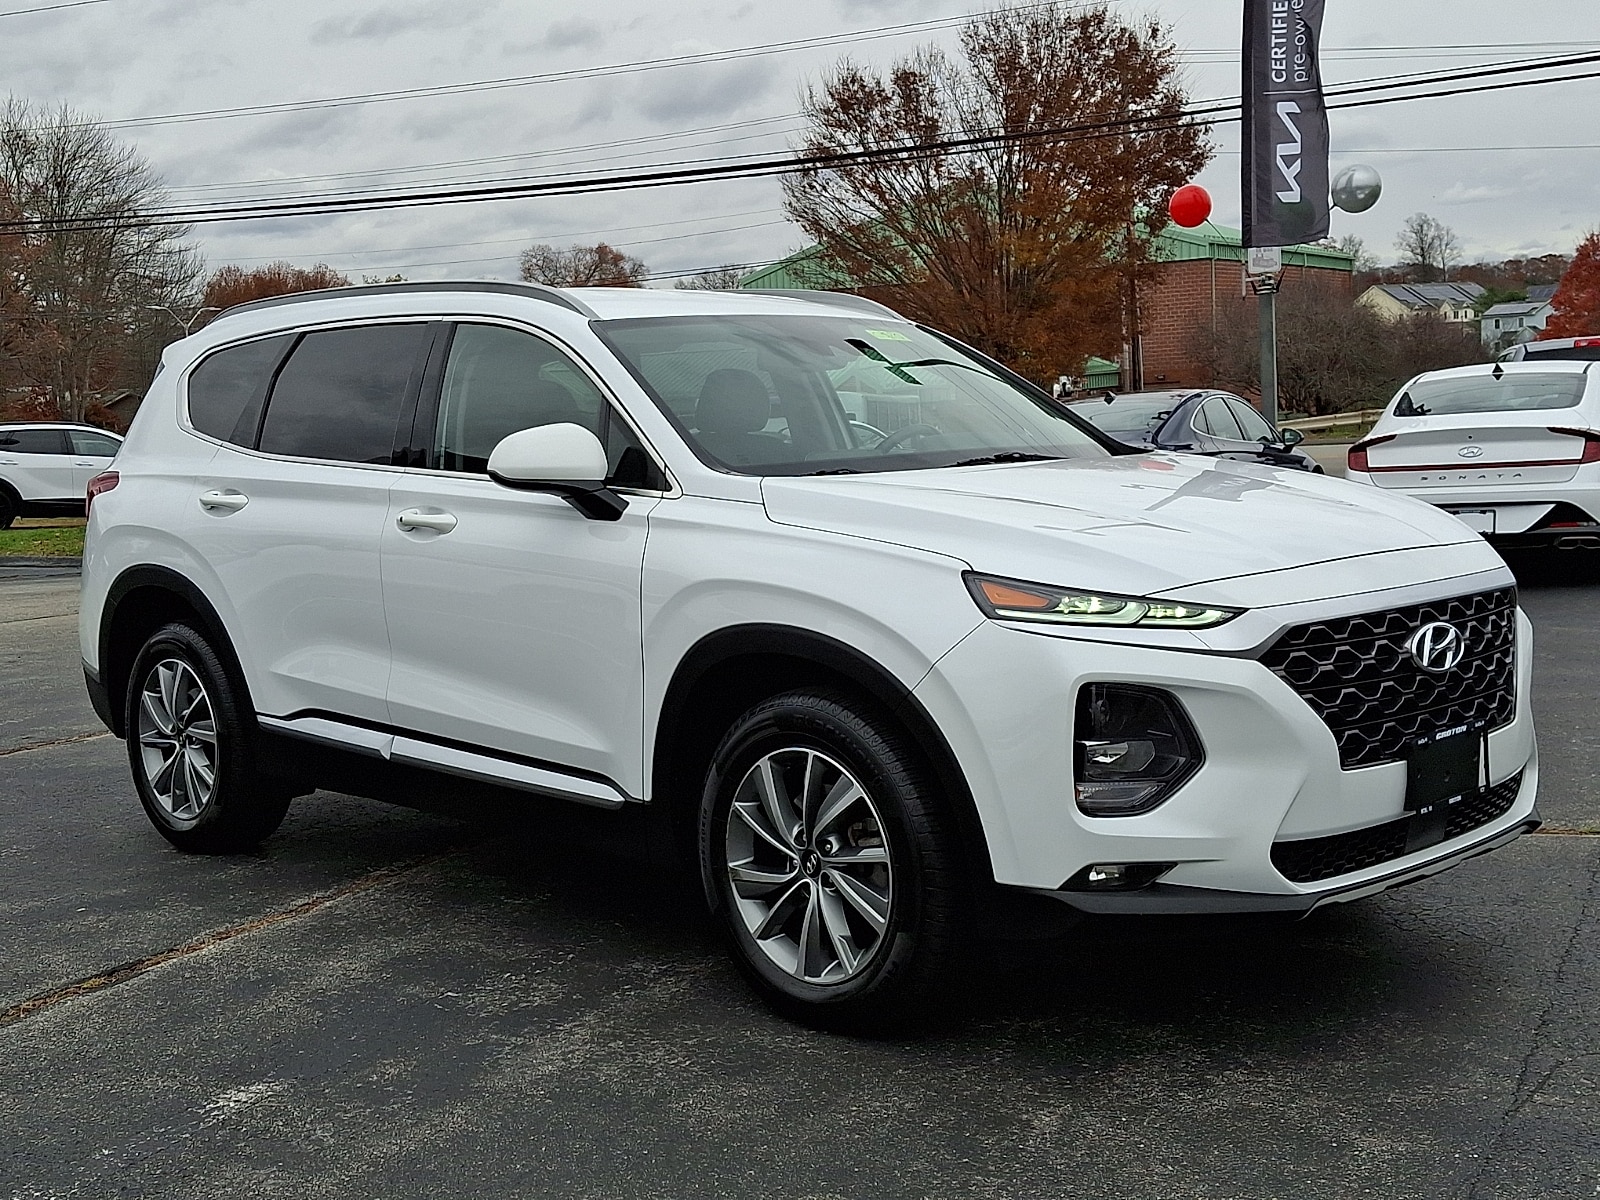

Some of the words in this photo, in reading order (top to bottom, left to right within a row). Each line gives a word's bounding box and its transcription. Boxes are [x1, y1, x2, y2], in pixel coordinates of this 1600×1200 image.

[1271, 0, 1289, 83] CERTIFIE
[1275, 101, 1302, 204] KIA
[1420, 472, 1522, 481] SONATA
[1435, 724, 1468, 741] GROTON
